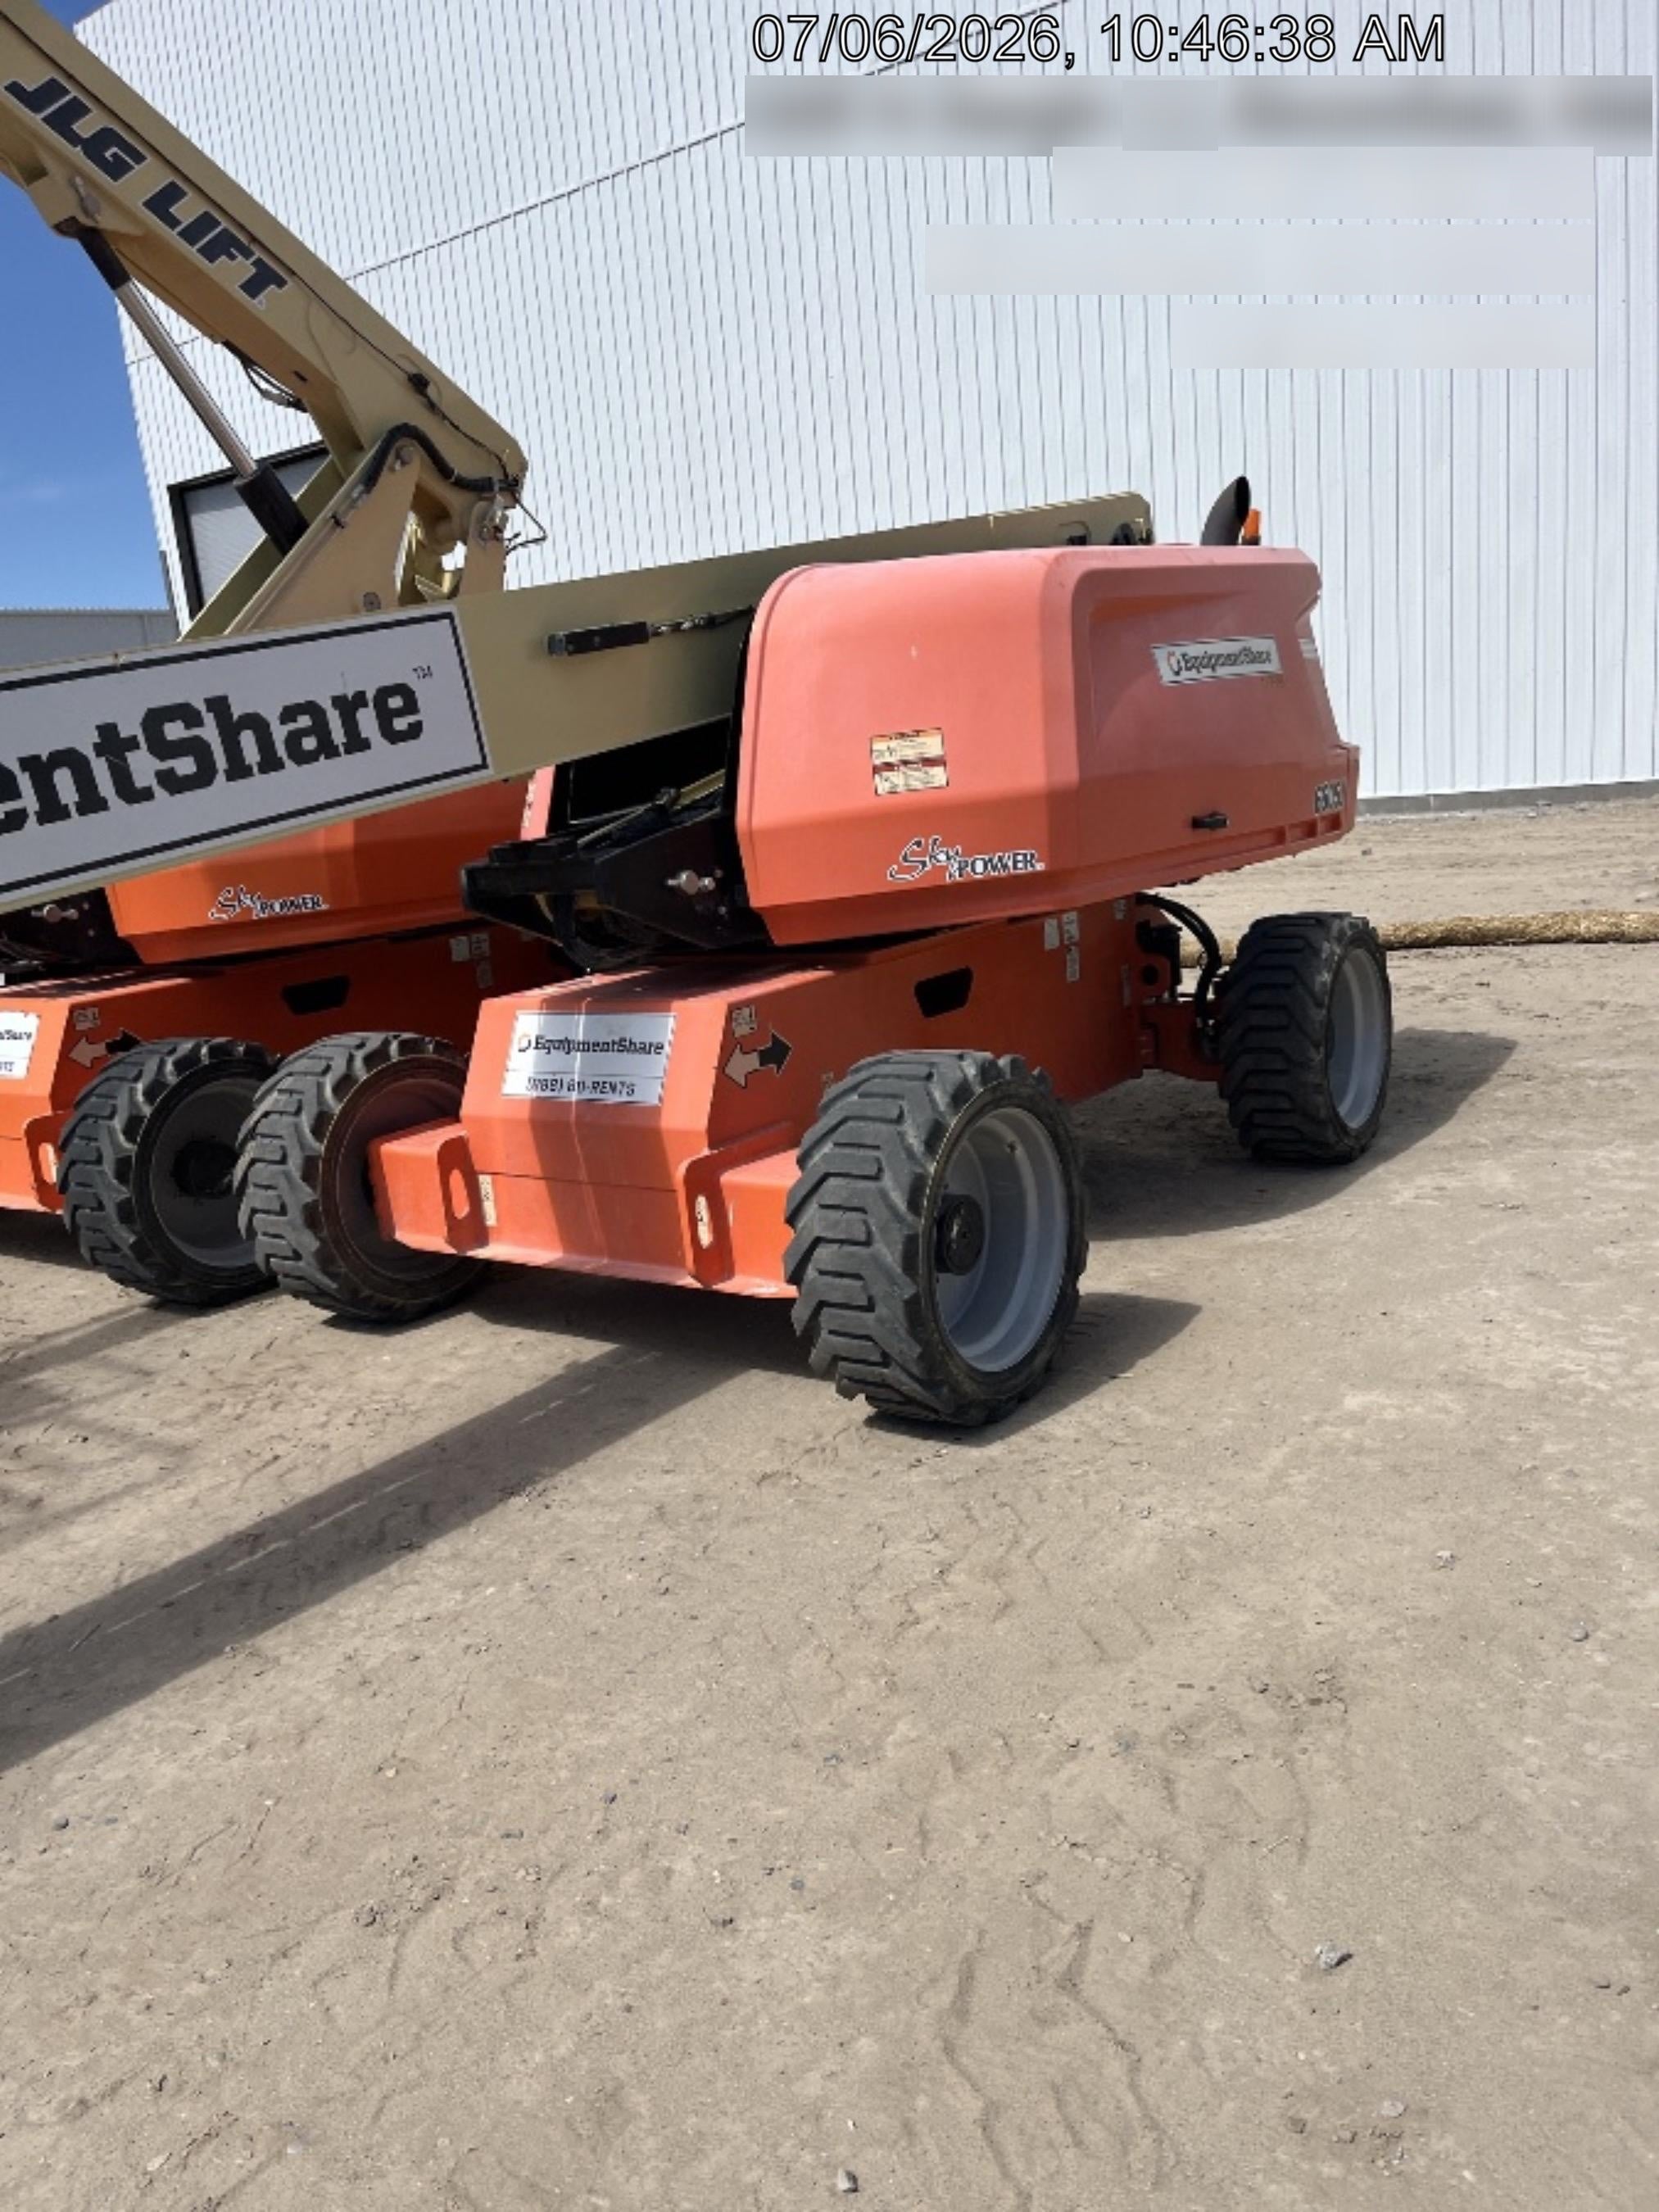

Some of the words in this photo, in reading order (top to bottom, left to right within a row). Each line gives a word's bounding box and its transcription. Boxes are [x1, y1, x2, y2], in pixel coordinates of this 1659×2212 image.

[3, 76, 149, 183] JLG
[141, 179, 289, 301] LIFT
[533, 1035, 664, 1056] EquipmentShare
